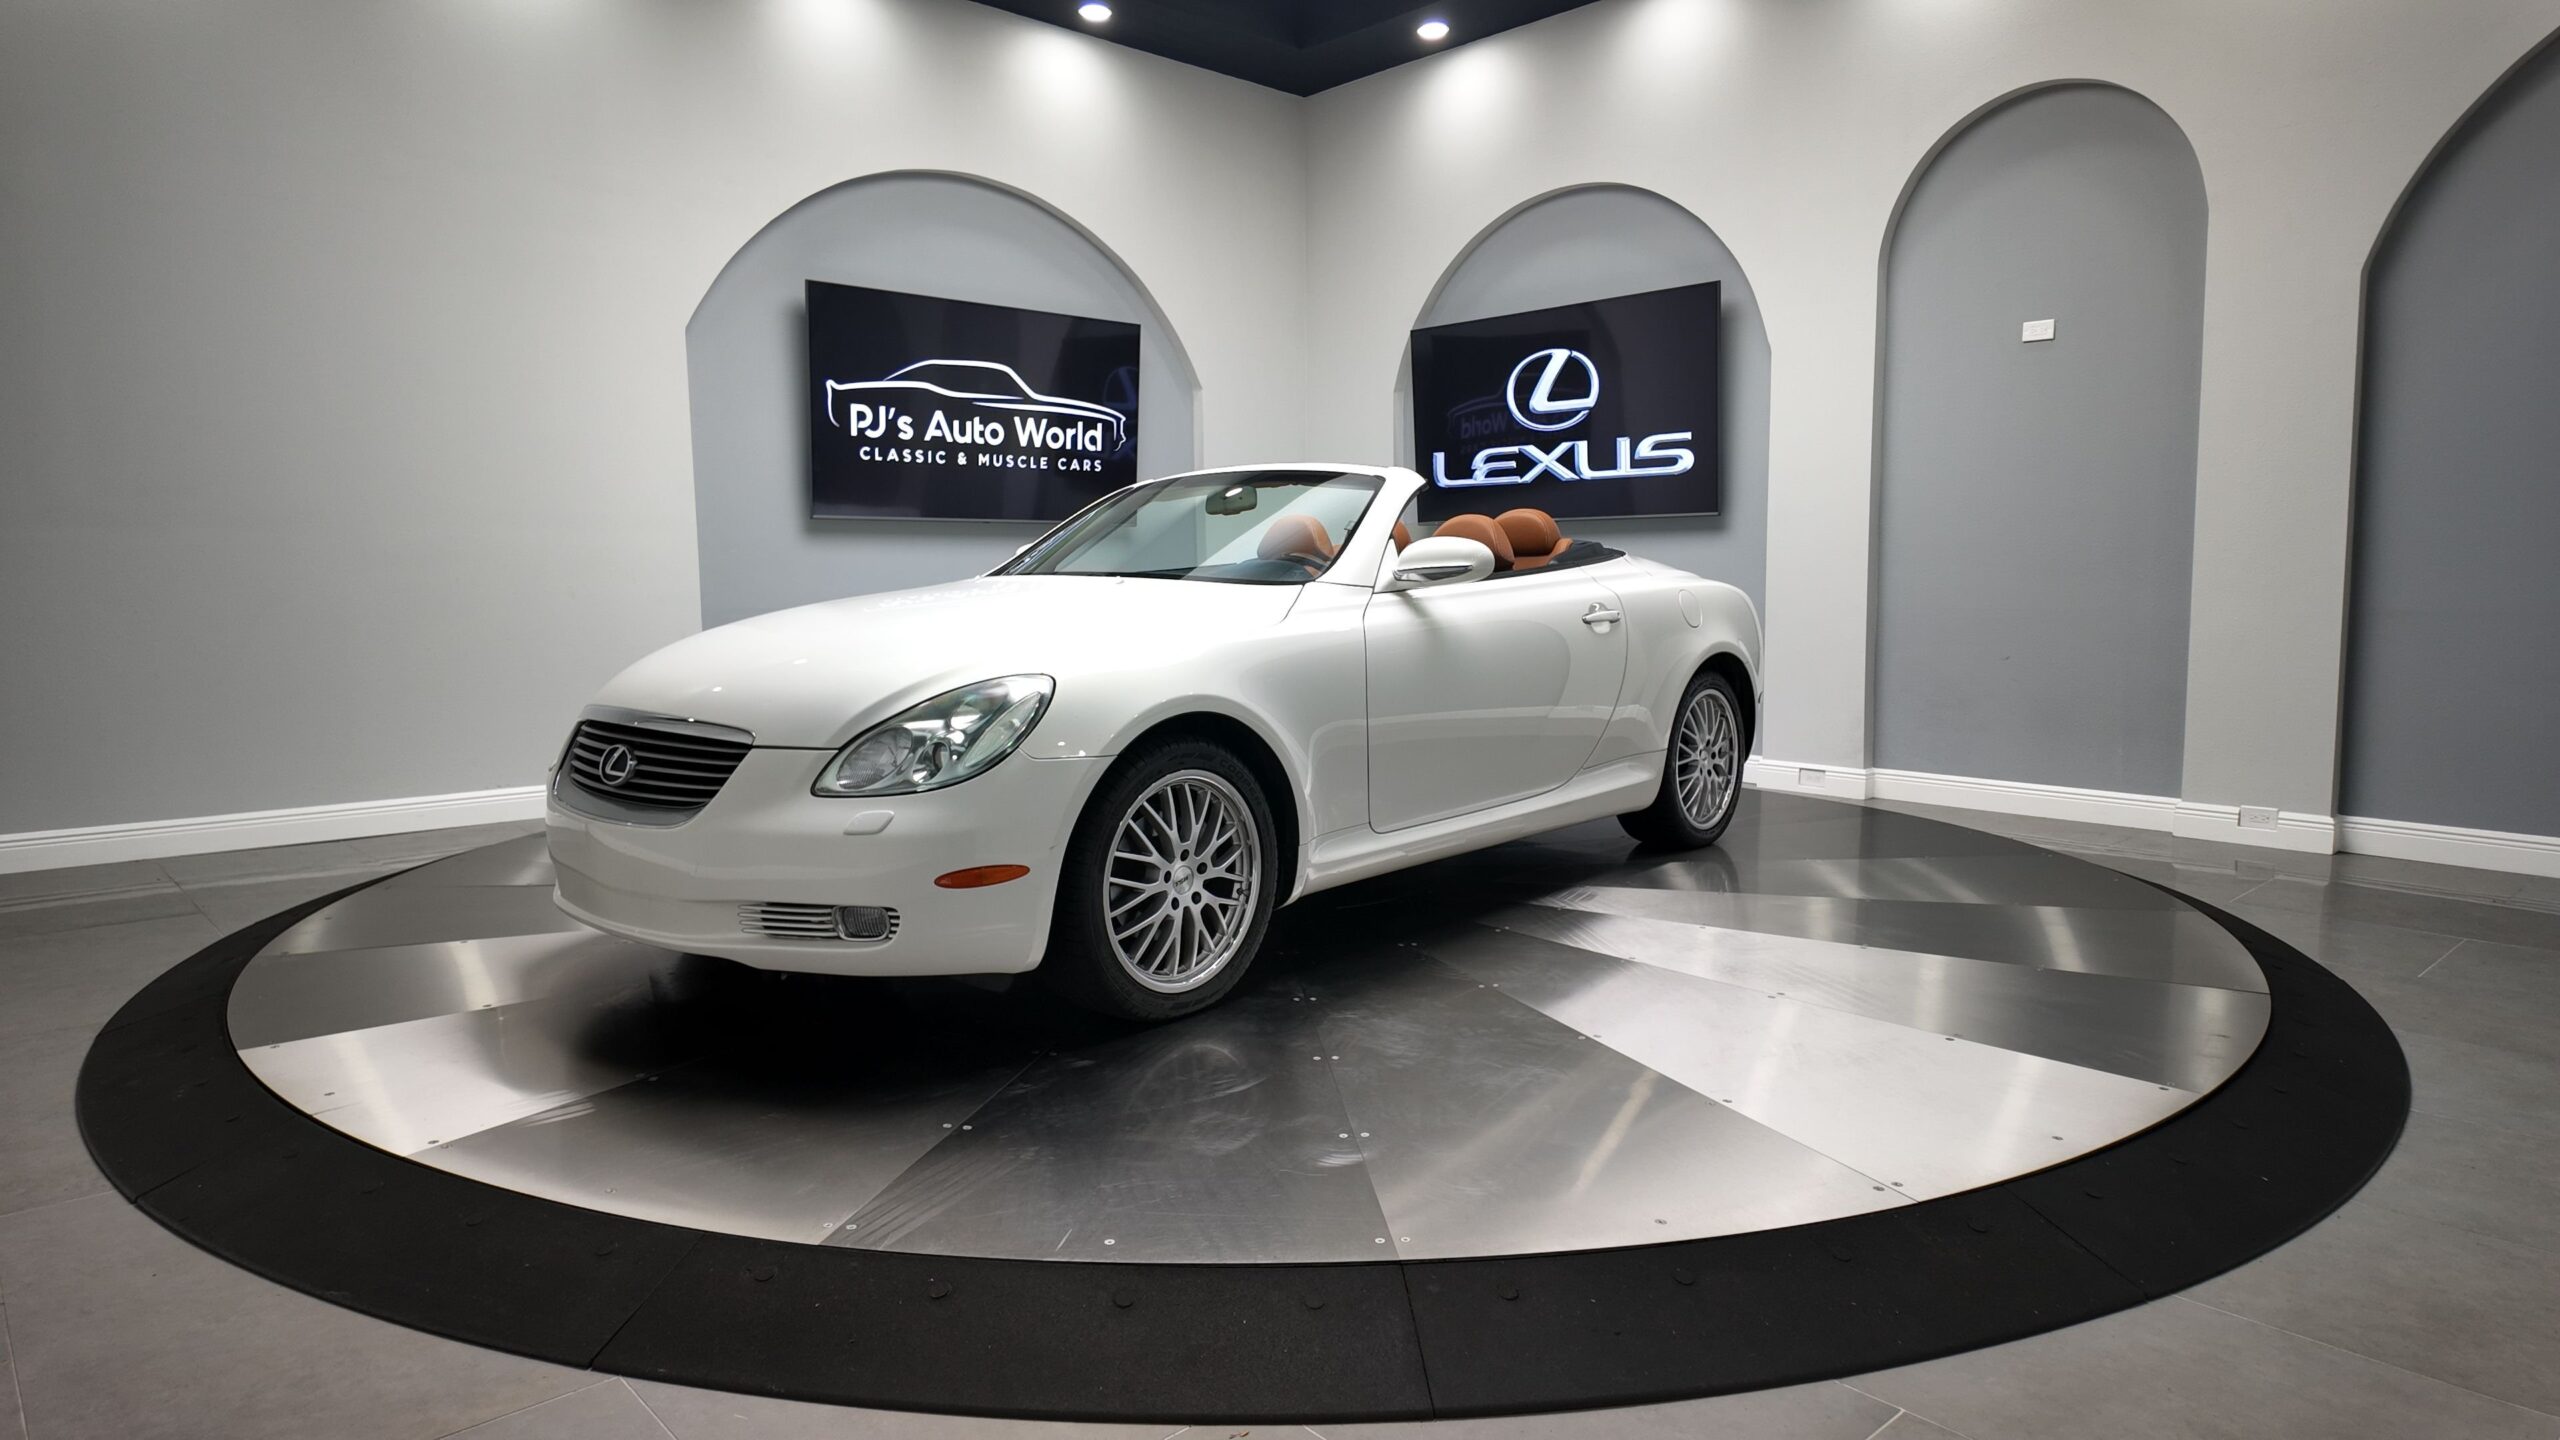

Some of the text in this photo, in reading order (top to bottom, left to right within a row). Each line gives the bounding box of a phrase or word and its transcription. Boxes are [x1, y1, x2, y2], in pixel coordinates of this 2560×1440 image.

[850, 403, 1103, 452] PJ's Auto World
[860, 446, 1102, 472] CLASSIC & MUSCLE CARS
[1432, 431, 1695, 488] LEXUS
